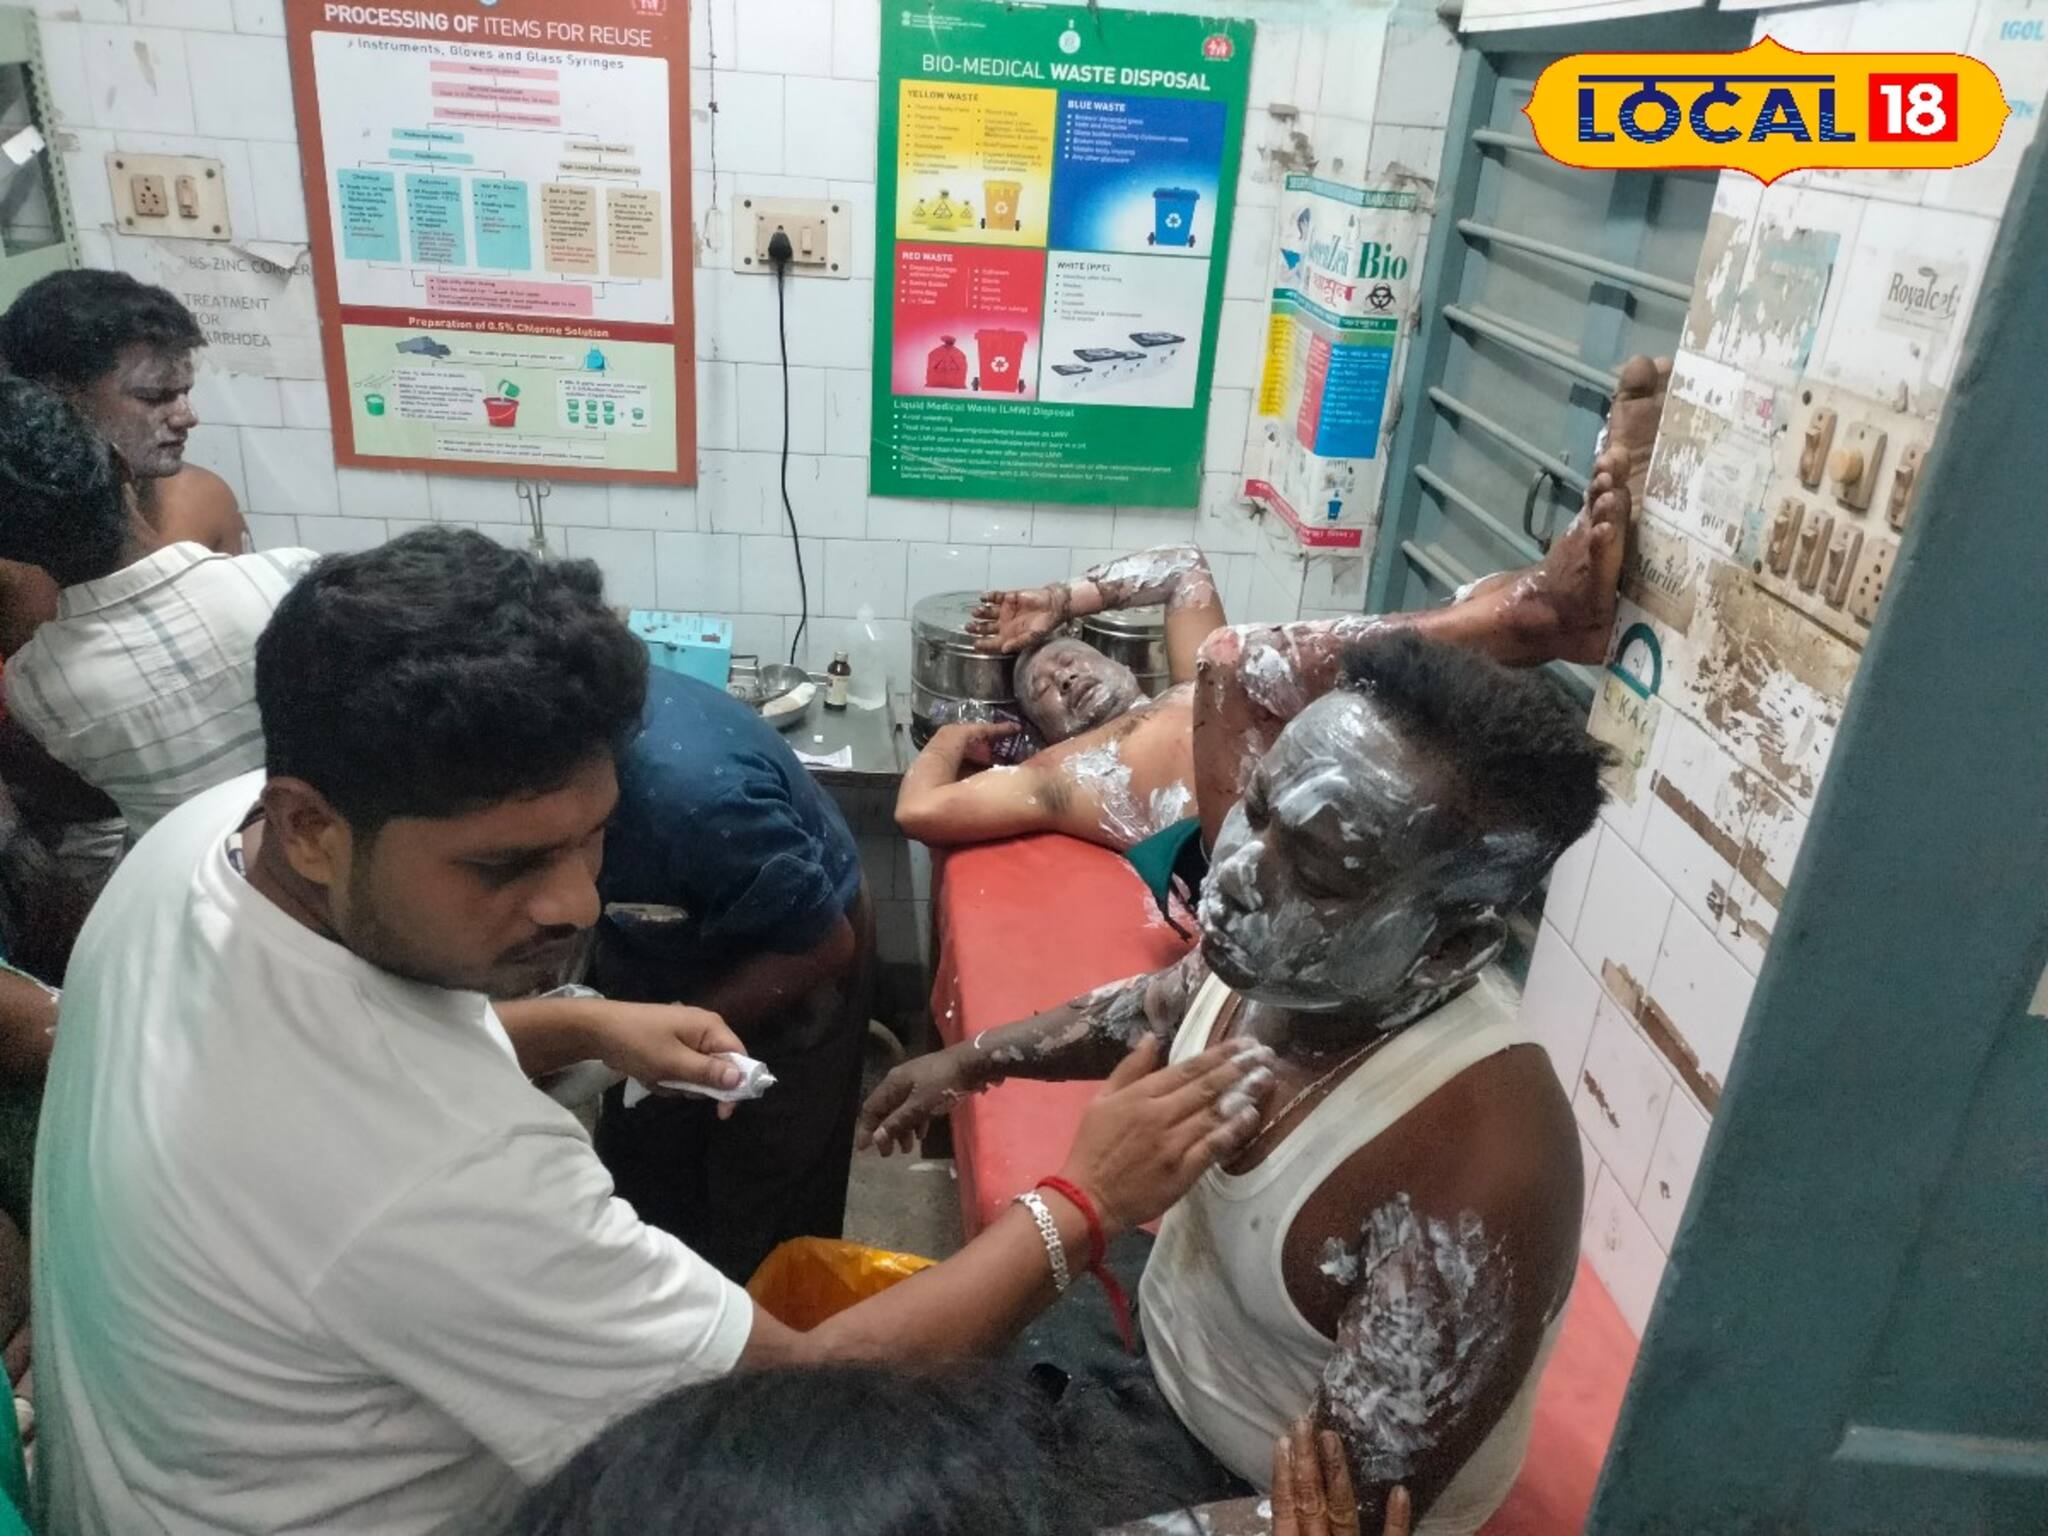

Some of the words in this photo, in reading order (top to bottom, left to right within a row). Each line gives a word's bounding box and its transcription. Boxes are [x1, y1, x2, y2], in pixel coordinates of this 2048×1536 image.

[324, 3, 449, 31] PROCESSING
[454, 15, 479, 34] OF
[484, 16, 542, 39] ITEMS
[547, 21, 584, 42] FOR
[590, 25, 653, 48] REUSE
[450, 45, 493, 59] Gloves
[498, 51, 522, 62] and
[526, 51, 563, 64] Glass
[567, 55, 625, 71] Syringes
[922, 53, 1045, 79] BIO-MEDICAL
[1050, 62, 1115, 85] WASTE
[1120, 67, 1210, 91] DISPOSAL
[907, 89, 944, 101] YELLOW
[946, 91, 980, 102] WASTE
[1067, 100, 1092, 110] BLUE
[1094, 101, 1126, 112] WASTE
[902, 251, 921, 260] RED
[923, 252, 953, 263] WASTE
[1057, 261, 1085, 271] WHITE
[1356, 241, 1408, 281] Bio
[183, 293, 270, 311] TREATMENT
[408, 316, 474, 331] Preparation
[475, 320, 486, 330] of
[487, 321, 515, 332] 0.5%
[516, 322, 562, 336] Chlorine
[564, 325, 609, 339] Solution
[206, 330, 272, 347] ARRHOEA
[893, 400, 925, 411] Liquid
[926, 401, 965, 412] Medical
[967, 403, 997, 414] Waste
[1033, 405, 1075, 419] Disposal
